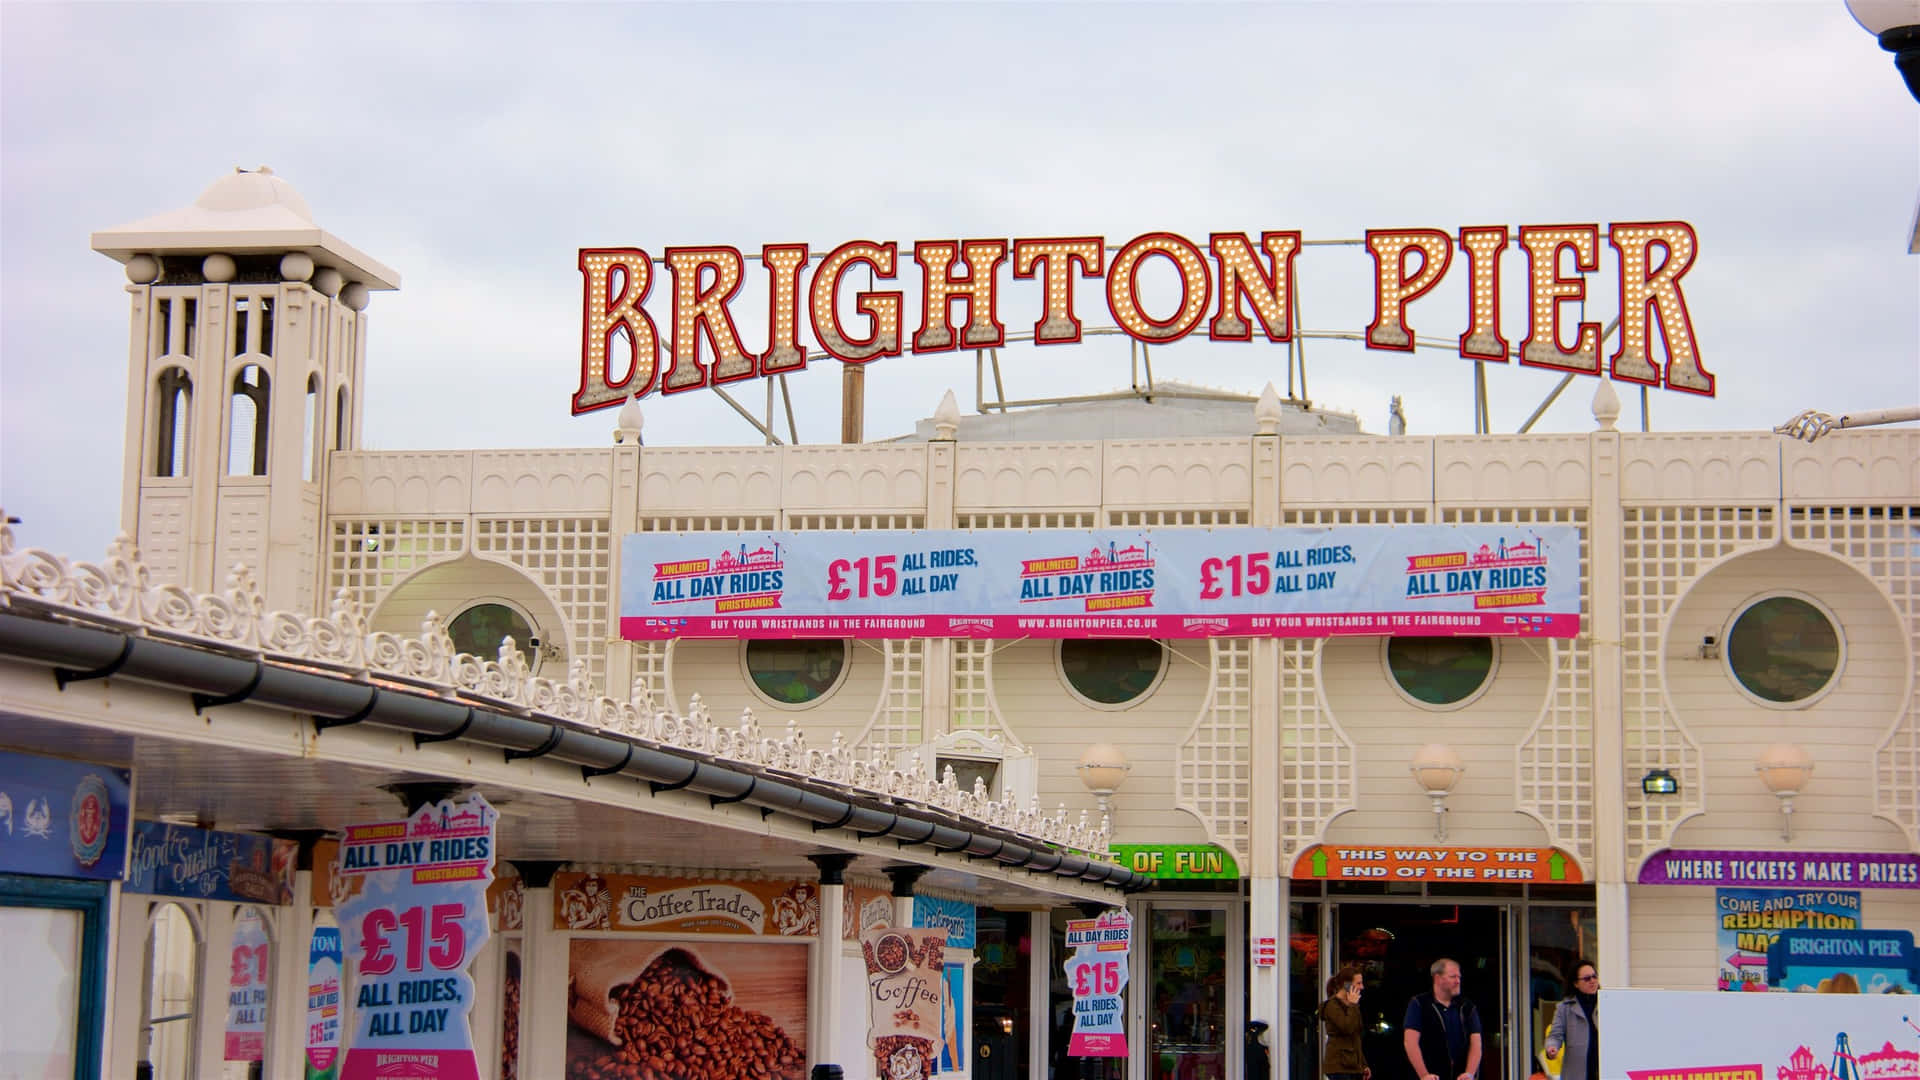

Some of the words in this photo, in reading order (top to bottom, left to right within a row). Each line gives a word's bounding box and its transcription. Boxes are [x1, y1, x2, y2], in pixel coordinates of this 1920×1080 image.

[571, 231, 1301, 416] BRIGHTON
[1366, 221, 1715, 397] PIER
[902, 553, 926, 571] ALL
[930, 548, 978, 567] RIDES,
[1029, 559, 1077, 572] UNLIMITED
[1276, 551, 1303, 569] ALL
[1306, 545, 1356, 566] RIDES,
[1415, 554, 1464, 568] UNLIMITED
[662, 561, 708, 575] UNLIMITED
[1200, 552, 1271, 600] £15
[653, 579, 685, 601] ALL
[690, 575, 725, 597] DAY
[730, 570, 783, 594] RIDES
[827, 555, 898, 601] £15
[901, 577, 926, 596] ALL
[930, 573, 959, 592] DAY
[1020, 578, 1053, 599] ALL
[1059, 574, 1095, 595] DAY
[1100, 568, 1155, 593] RIDES
[1276, 575, 1302, 593] ALL
[1306, 571, 1337, 590] DAY
[1407, 573, 1440, 596] ALL
[1446, 570, 1483, 592] DAY
[1489, 566, 1547, 589] RIDES
[718, 597, 775, 611] WRISTBANDS
[1088, 595, 1146, 610] WRISTBANDS
[1477, 593, 1538, 608] WRISTBANDS
[711, 620, 729, 629] BUY
[733, 619, 758, 629] YOUR
[762, 619, 825, 629] WRISTBANDS
[829, 619, 839, 629] IN
[843, 619, 860, 628] THE
[865, 618, 925, 628] FAIRGROUND
[1018, 618, 1158, 629] WWW.BRIGHTONPIER.CO.UK
[1252, 618, 1271, 627] BUY
[1275, 617, 1301, 627] YOUR
[1306, 616, 1372, 627] WRISTBANDS
[1377, 616, 1388, 625] IN
[1392, 616, 1410, 625] THE
[1415, 616, 1481, 626] FAIRGROUND
[353, 824, 404, 840] UNLIMITED
[343, 845, 379, 869] ALL
[386, 841, 424, 866] DAY
[430, 836, 489, 862] RIDES
[1133, 851, 1163, 873] OF
[1175, 851, 1223, 873] FUN
[1336, 850, 1387, 861] THIS
[1394, 850, 1448, 861] WAY
[1453, 851, 1487, 862] TO
[1495, 851, 1537, 863] THE
[416, 865, 479, 881] WRISTBANDS
[1341, 866, 1388, 877] END
[1396, 867, 1427, 878] OF
[1432, 867, 1476, 878] THE
[1483, 868, 1534, 879] PIER
[1665, 859, 1723, 880] WHERE
[1729, 860, 1797, 881] TICKETS
[1803, 862, 1852, 881] MAKE
[1859, 863, 1918, 883] PRIZES
[629, 886, 647, 899] THE
[1719, 896, 1760, 912] COME
[1764, 896, 1794, 910] AND
[1797, 893, 1824, 907] TRY
[1827, 892, 1858, 909] OUR
[627, 893, 693, 923] Coffee
[692, 889, 761, 924] Trader
[1722, 909, 1857, 930] REDEMPTION
[359, 903, 466, 976] £15
[1068, 931, 1083, 943] ALL
[1086, 930, 1102, 942] DAY
[1104, 928, 1129, 940] RIDES
[1790, 938, 1863, 956] BRIGHTON
[1868, 939, 1903, 957] PIER
[1075, 961, 1120, 997] £15
[230, 990, 250, 1008] ALL
[357, 983, 393, 1008] ALL
[398, 977, 462, 1007] RIDES,
[871, 975, 938, 1009] Coffee
[1075, 1000, 1090, 1013] ALL
[1092, 998, 1119, 1011] RIDES,
[235, 1008, 256, 1024] ALL
[368, 1012, 404, 1037] ALL
[410, 1008, 449, 1033] DAY
[1080, 1015, 1095, 1028] ALL
[1097, 1013, 1114, 1026] DAY
[376, 1054, 417, 1068] BRIGHTON
[420, 1055, 438, 1069] PIER
